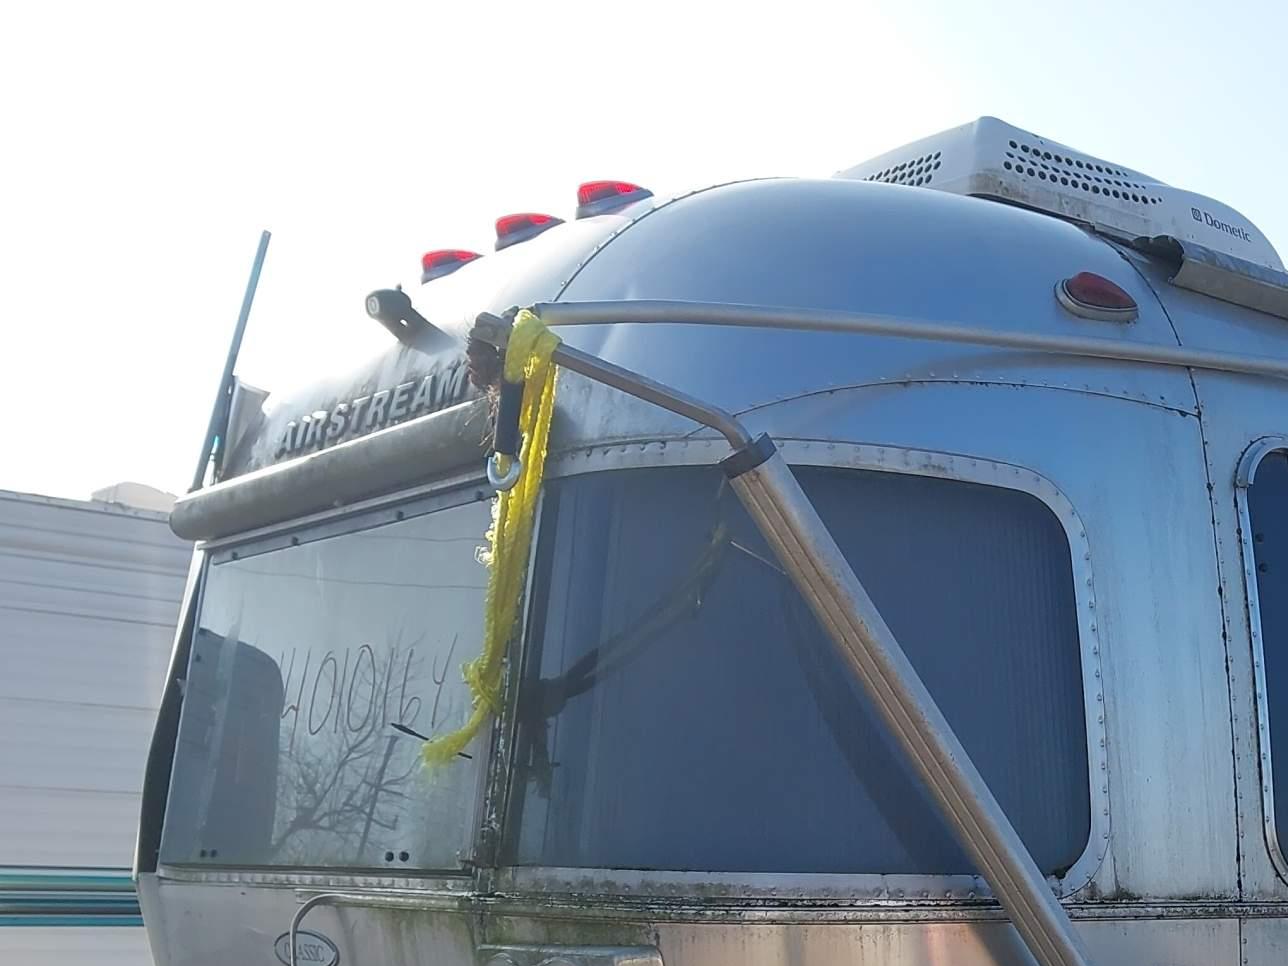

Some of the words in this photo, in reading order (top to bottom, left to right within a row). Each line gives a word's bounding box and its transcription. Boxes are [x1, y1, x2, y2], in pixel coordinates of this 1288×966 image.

[1204, 211, 1251, 242] Dometic
[276, 366, 468, 455] AIRSTREAM
[284, 942, 325, 962] CASSIC
